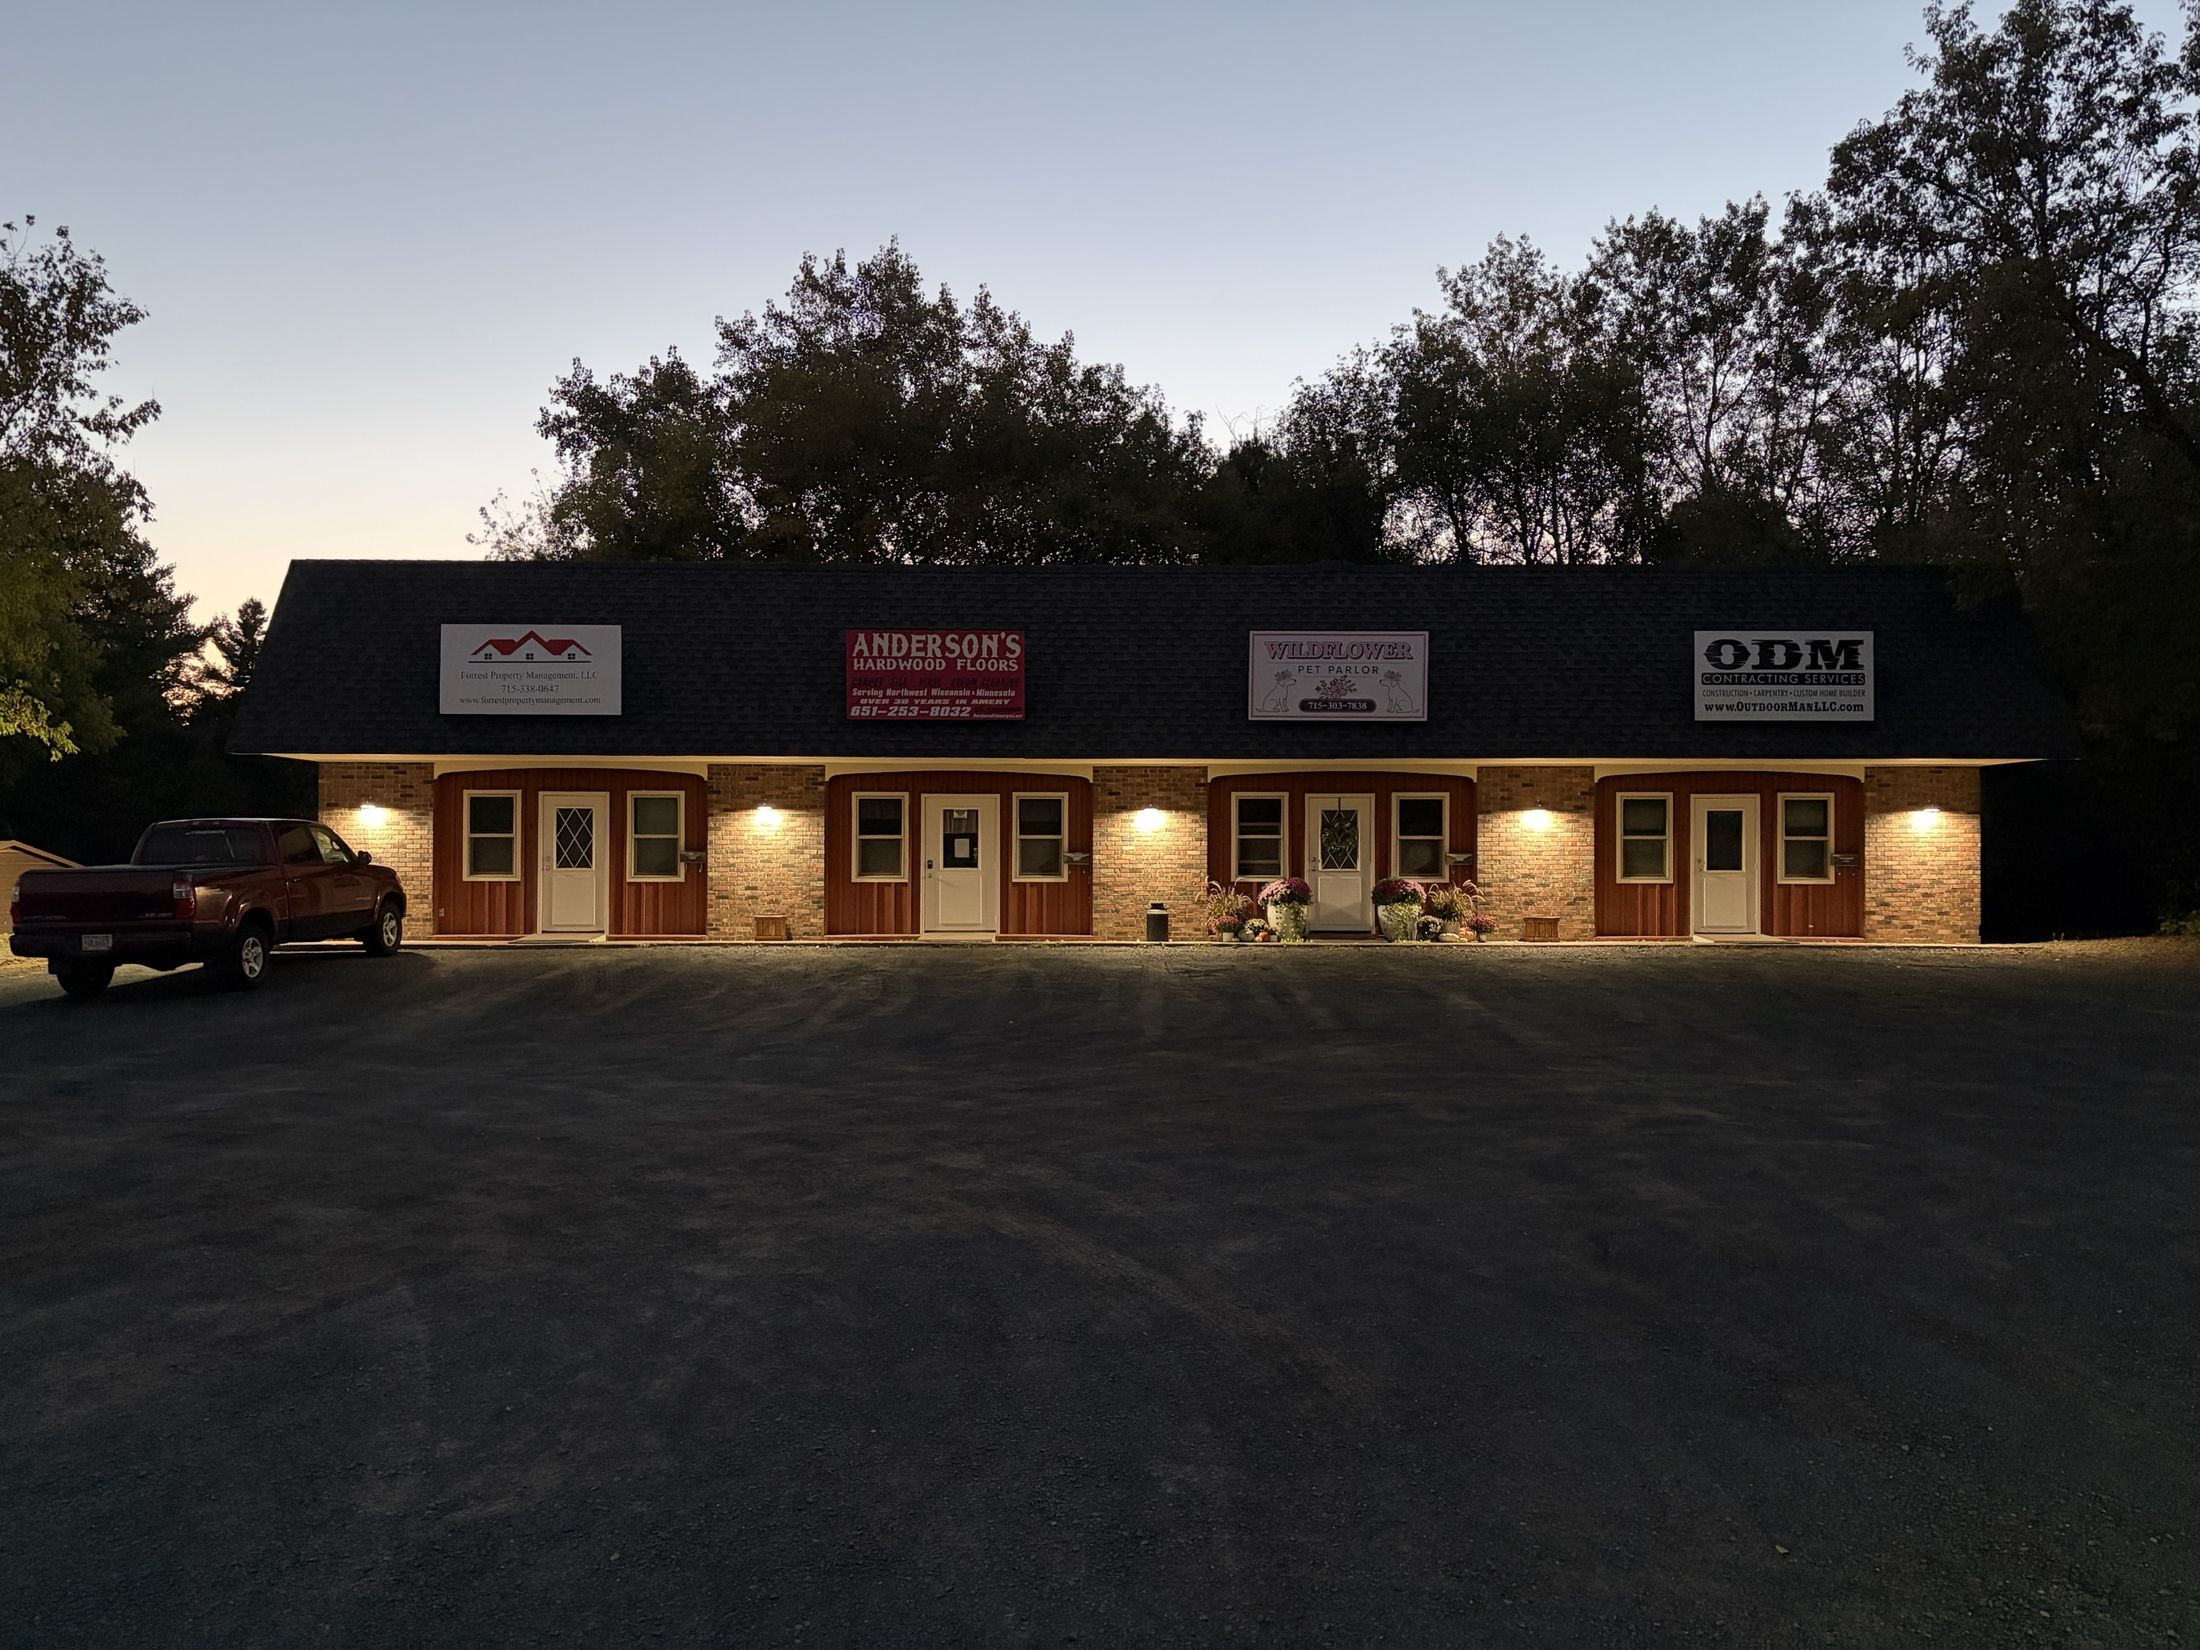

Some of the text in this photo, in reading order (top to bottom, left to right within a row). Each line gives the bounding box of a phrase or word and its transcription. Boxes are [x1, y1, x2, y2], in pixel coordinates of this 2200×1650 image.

[852, 632, 1022, 658] ANDERSON'S
[1264, 641, 1414, 660] WILDFLOWER
[1704, 638, 1864, 670] ODM
[853, 658, 1018, 672] HARDWOOD FLOORS
[1298, 665, 1380, 674] PET PARLOR
[461, 671, 599, 681] Forrest Property Management, LLC
[1702, 674, 1864, 684] CONTRACTING SERVICES
[501, 685, 560, 694] 715-338-0647
[852, 688, 884, 698] Serving
[886, 688, 928, 696] Northwest
[931, 688, 970, 697] Wisconsin
[976, 688, 1016, 697] Minnesota
[1702, 689, 1866, 698] CONSTRUCTION CARPENTRY CUSTOM HOME BUILDER
[459, 696, 601, 705] www.forrestpropertymanagement.com
[850, 706, 972, 716] 651-253-8032
[1308, 702, 1368, 710] 715-303-7838
